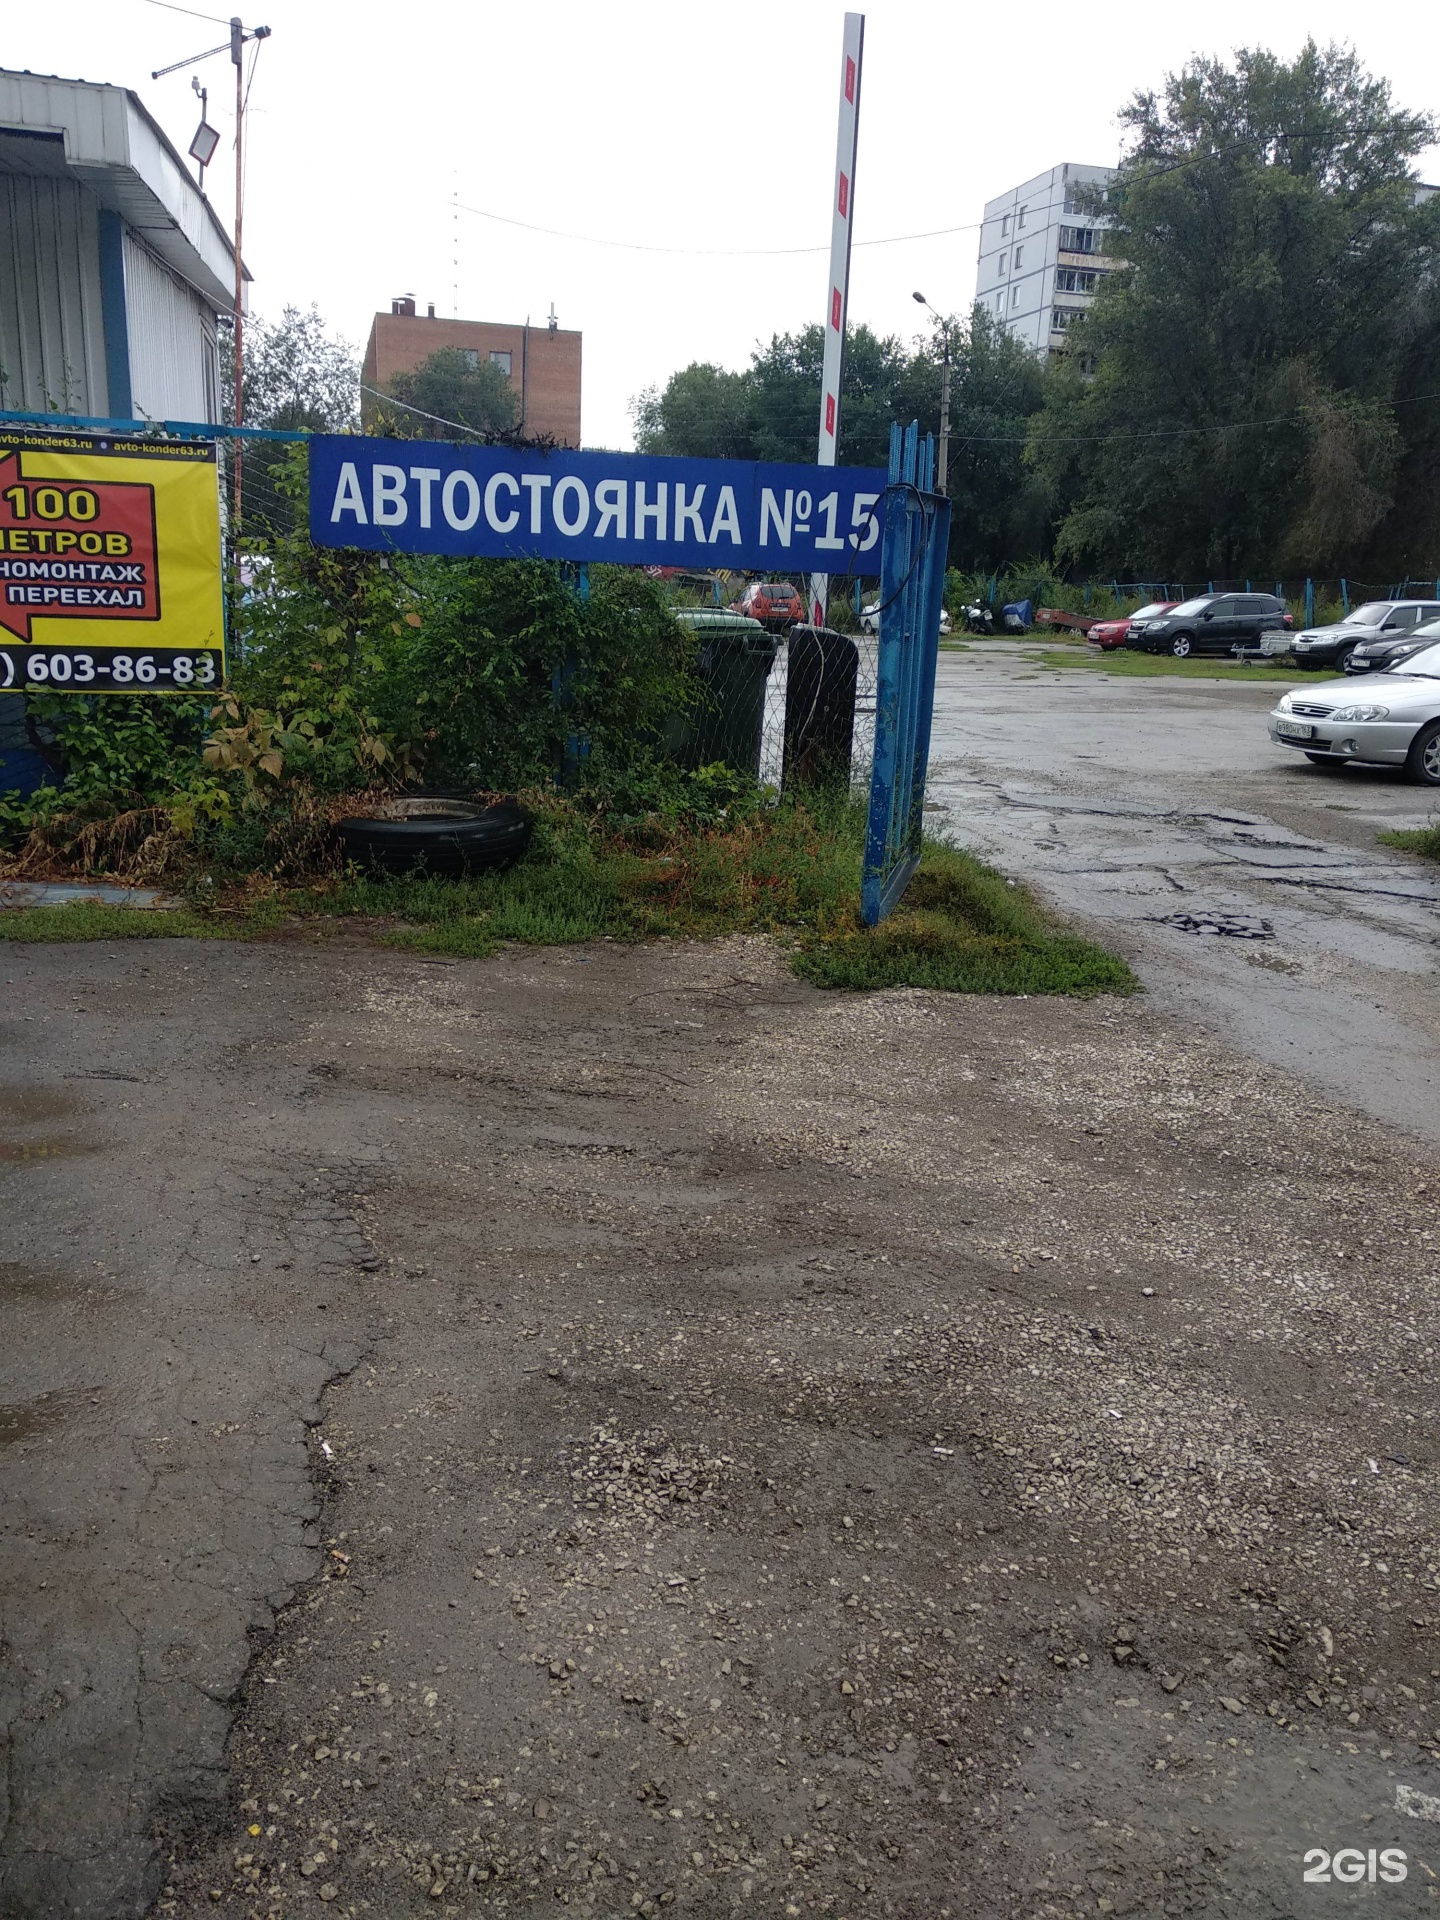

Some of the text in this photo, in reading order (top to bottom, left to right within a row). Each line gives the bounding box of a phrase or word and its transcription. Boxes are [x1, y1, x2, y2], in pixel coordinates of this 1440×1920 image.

[0, 434, 209, 456] vto-konder63.ru avto-konder63.ru
[6, 487, 96, 520] 100
[330, 461, 880, 552] АВТОСТОЯНКА №15
[0, 529, 129, 555] ЕТРОВ
[8, 586, 142, 606] ПЕРЕЕХАЛ
[26, 653, 216, 683] 603-86-83
